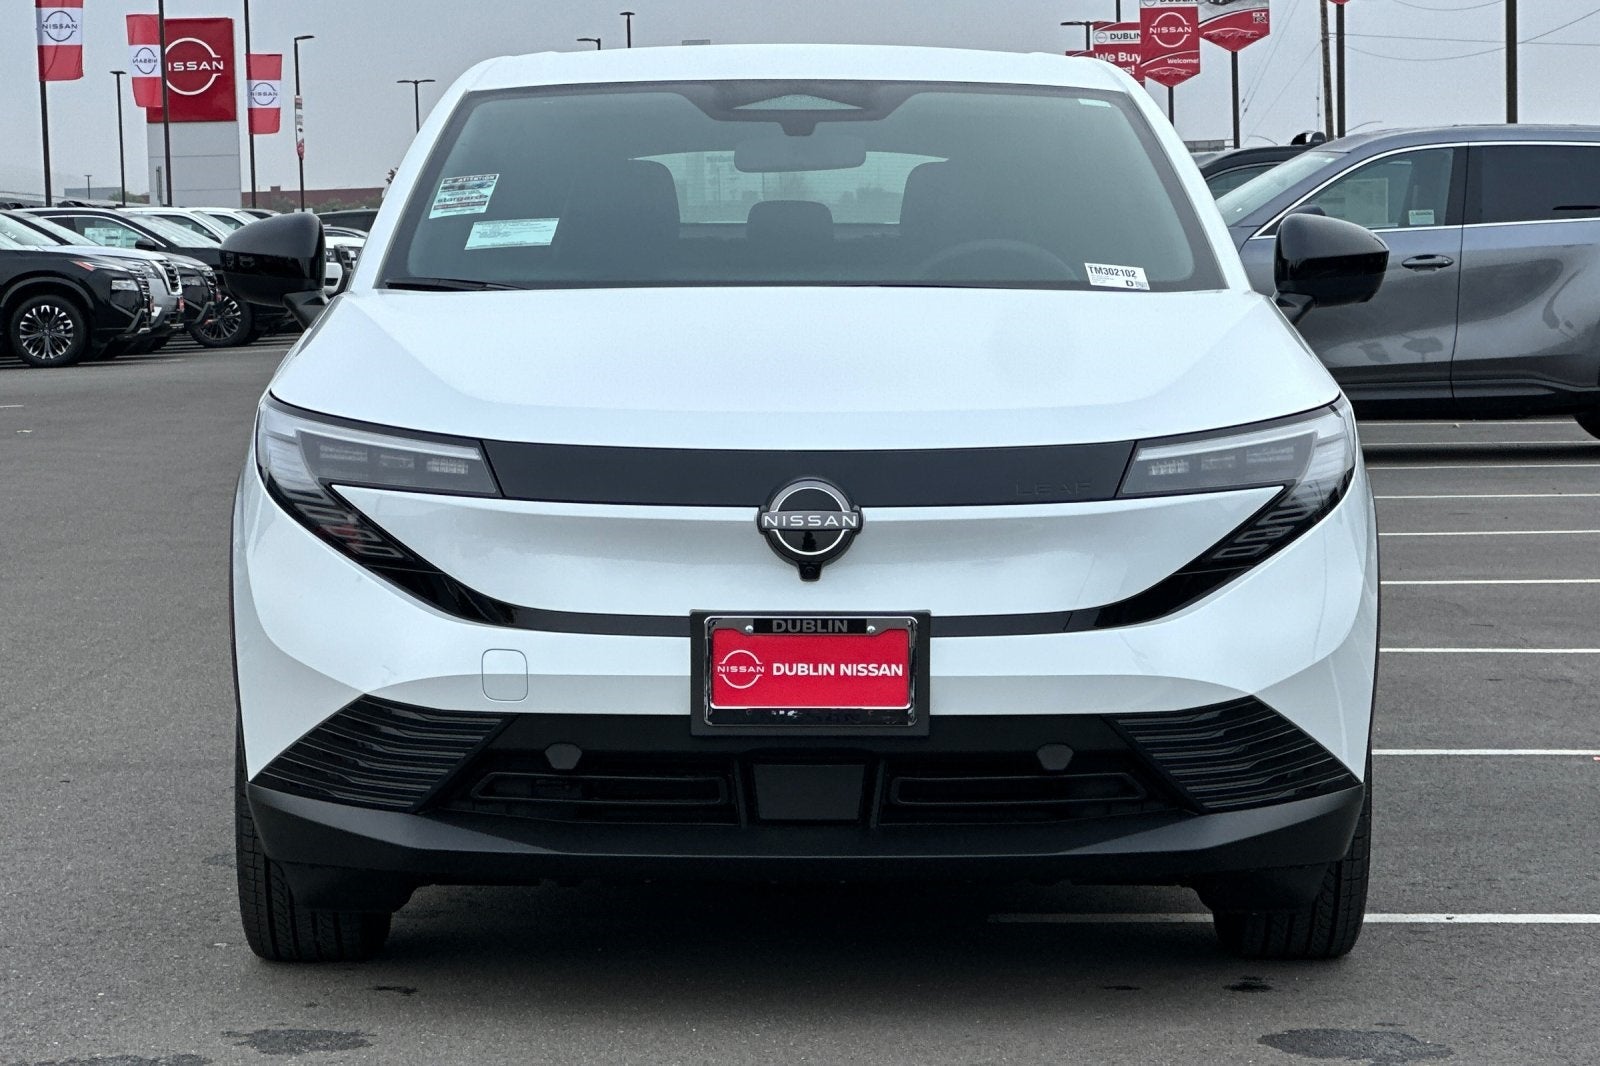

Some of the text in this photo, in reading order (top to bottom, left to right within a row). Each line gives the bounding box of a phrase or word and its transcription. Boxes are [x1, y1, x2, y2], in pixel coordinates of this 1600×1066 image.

[1149, 26, 1192, 34] NISSAN
[1095, 52, 1142, 64] We Buy
[168, 60, 224, 72] ISSAN
[1088, 265, 1136, 278] TM302102
[764, 515, 857, 527] NISSAN
[772, 619, 848, 633] DUBLIN
[717, 665, 765, 673] NISSAN
[772, 663, 903, 677] DUBLIN NISSAN
